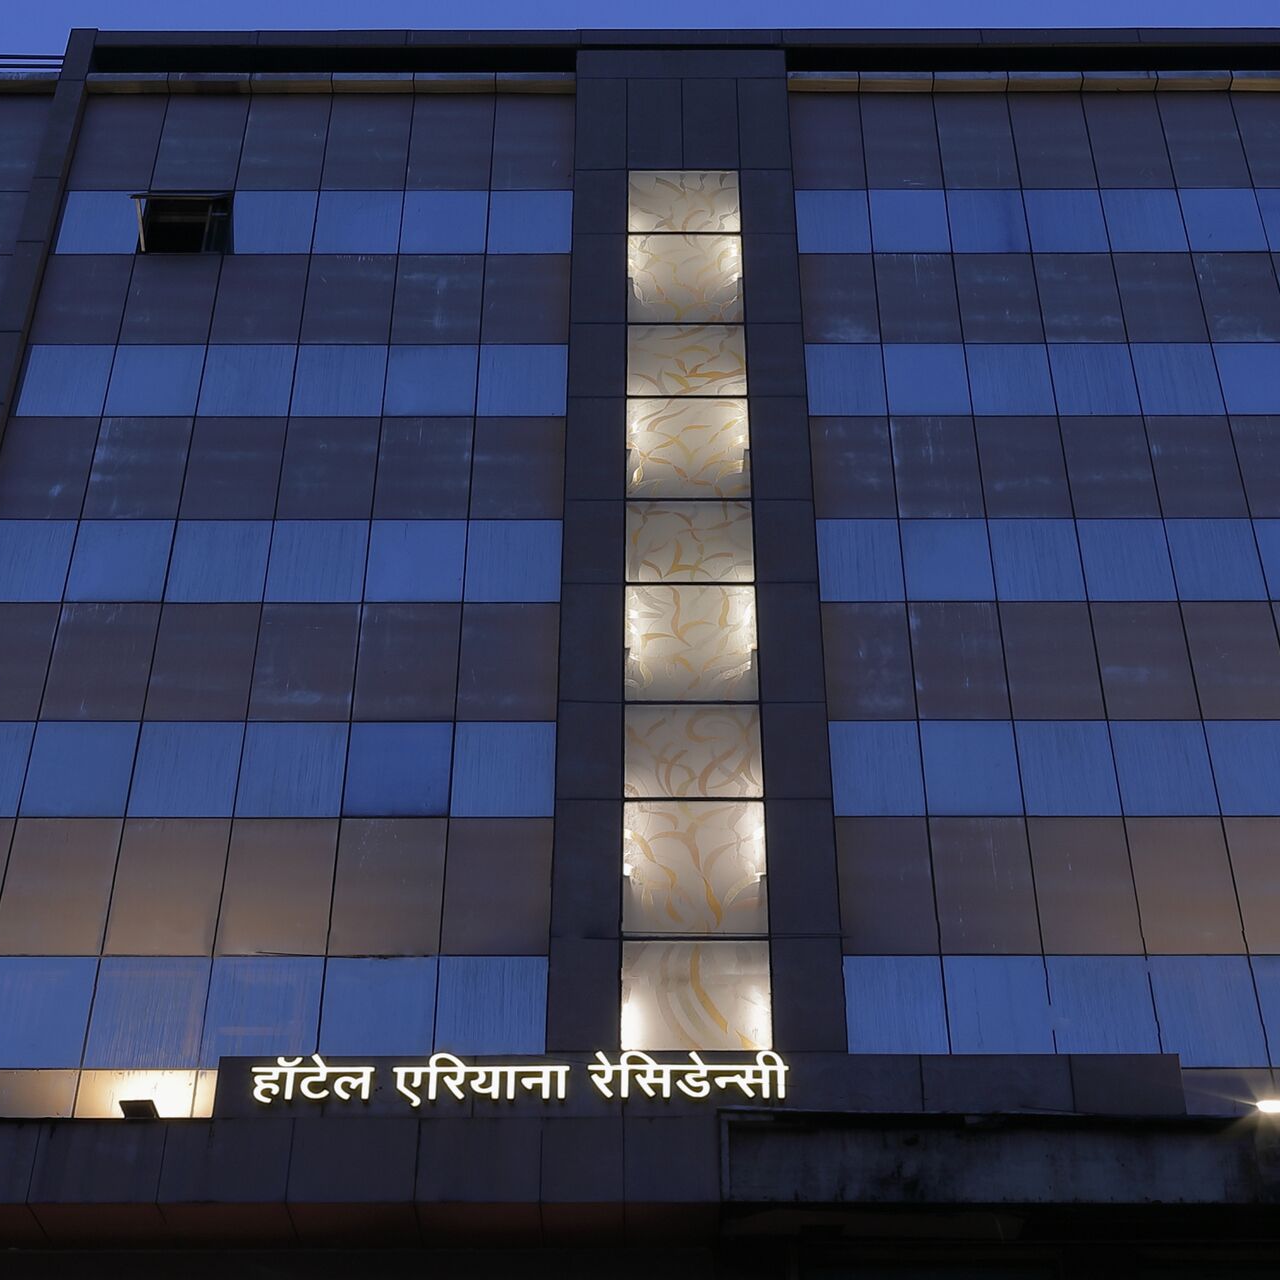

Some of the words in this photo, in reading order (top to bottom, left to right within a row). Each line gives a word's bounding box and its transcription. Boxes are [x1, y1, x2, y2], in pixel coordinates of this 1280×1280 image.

[252, 1054, 375, 1104] हॉटेल
[393, 1052, 569, 1107] एरियाना
[587, 1050, 789, 1100] रेसिडेन्सी
